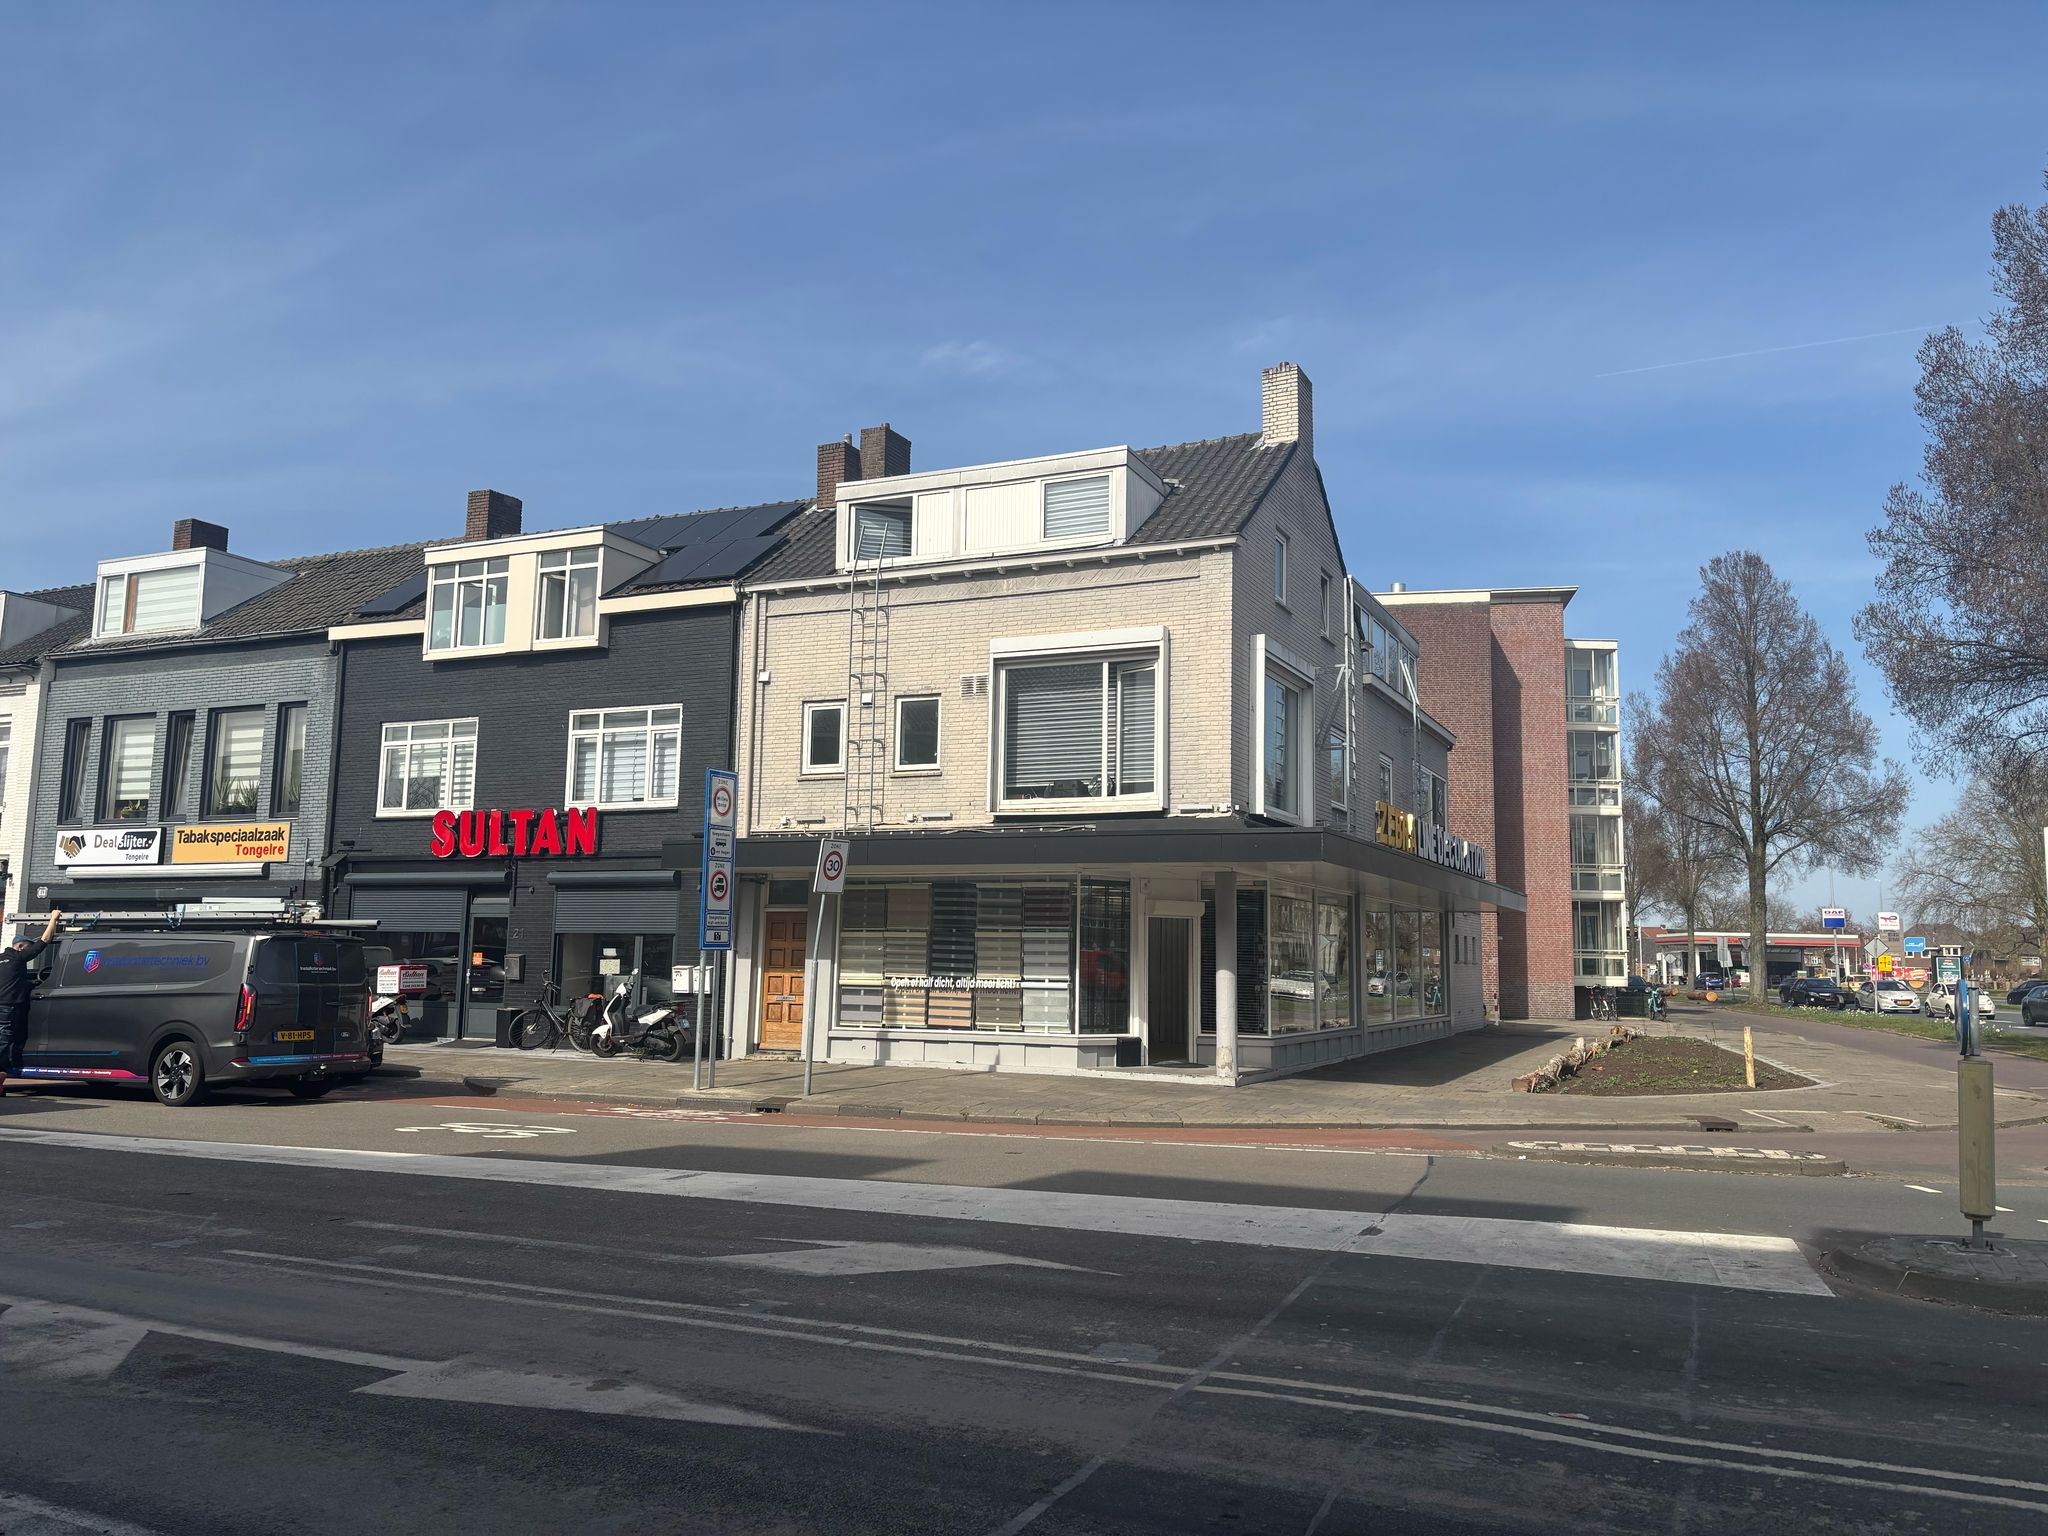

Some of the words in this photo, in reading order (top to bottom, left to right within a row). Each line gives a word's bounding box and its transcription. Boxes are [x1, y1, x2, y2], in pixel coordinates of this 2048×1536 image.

[717, 778, 729, 786] ZONE
[431, 806, 598, 858] SULTAN
[1375, 800, 1418, 857] ZEBRA
[177, 827, 285, 846] Tabakspeciaalzaak
[125, 853, 149, 862] Tongelre
[235, 843, 284, 858] Tongelre
[827, 860, 840, 872] 30
[919, 975, 934, 988] half
[934, 975, 955, 989] dicht,
[955, 975, 976, 991] altijd
[280, 1031, 312, 1040] V-81-HPS
